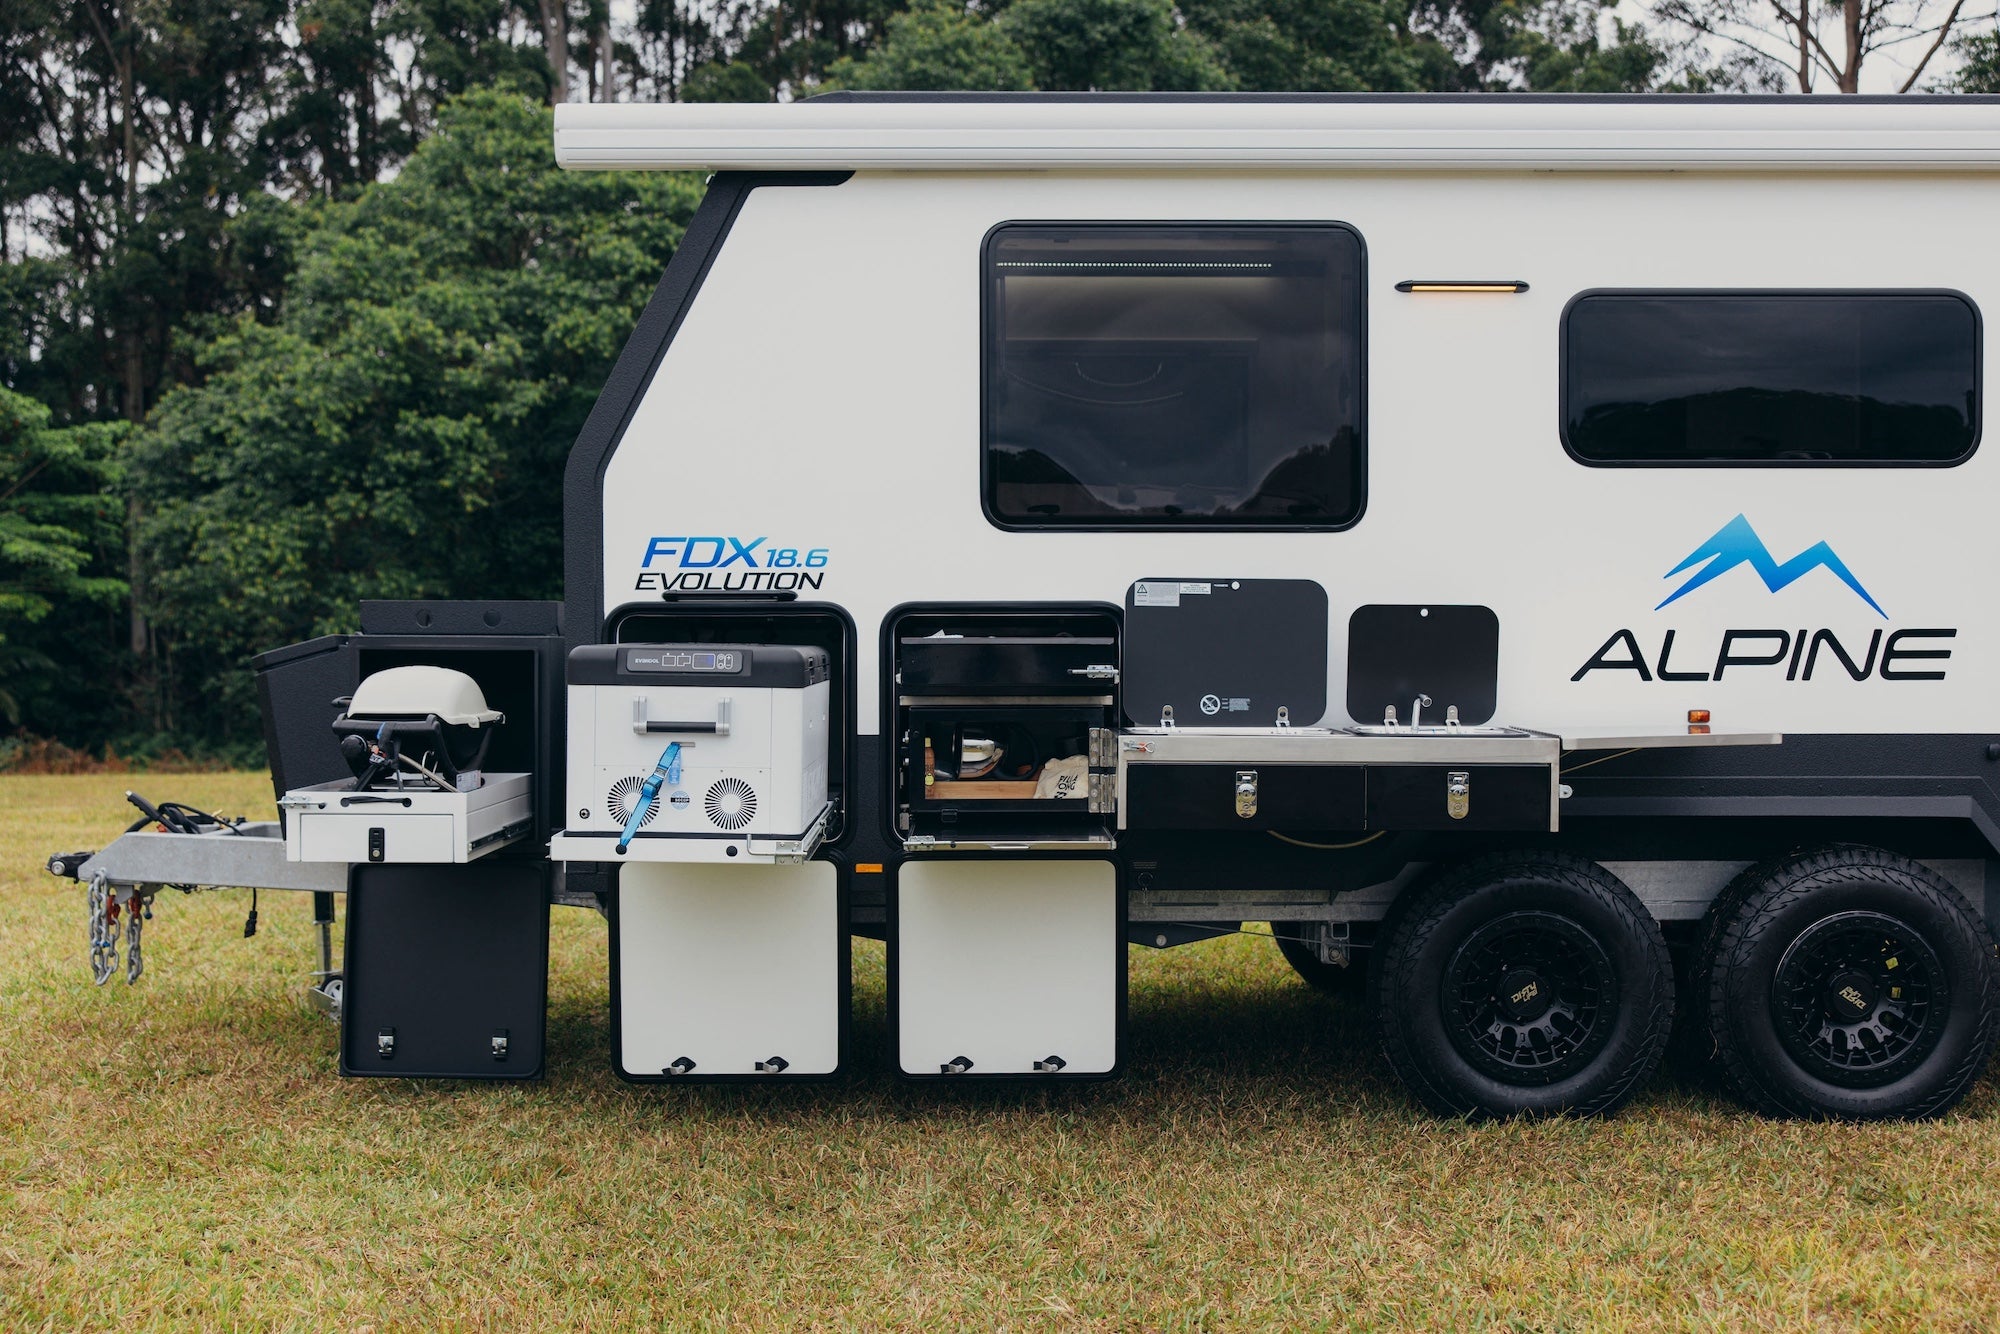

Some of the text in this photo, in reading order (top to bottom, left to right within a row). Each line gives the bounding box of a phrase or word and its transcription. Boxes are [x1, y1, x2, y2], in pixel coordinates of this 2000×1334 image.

[641, 536, 830, 568] FDX 18.6
[635, 572, 824, 590] EVOLUTION
[1571, 628, 1957, 681] ALPINE
